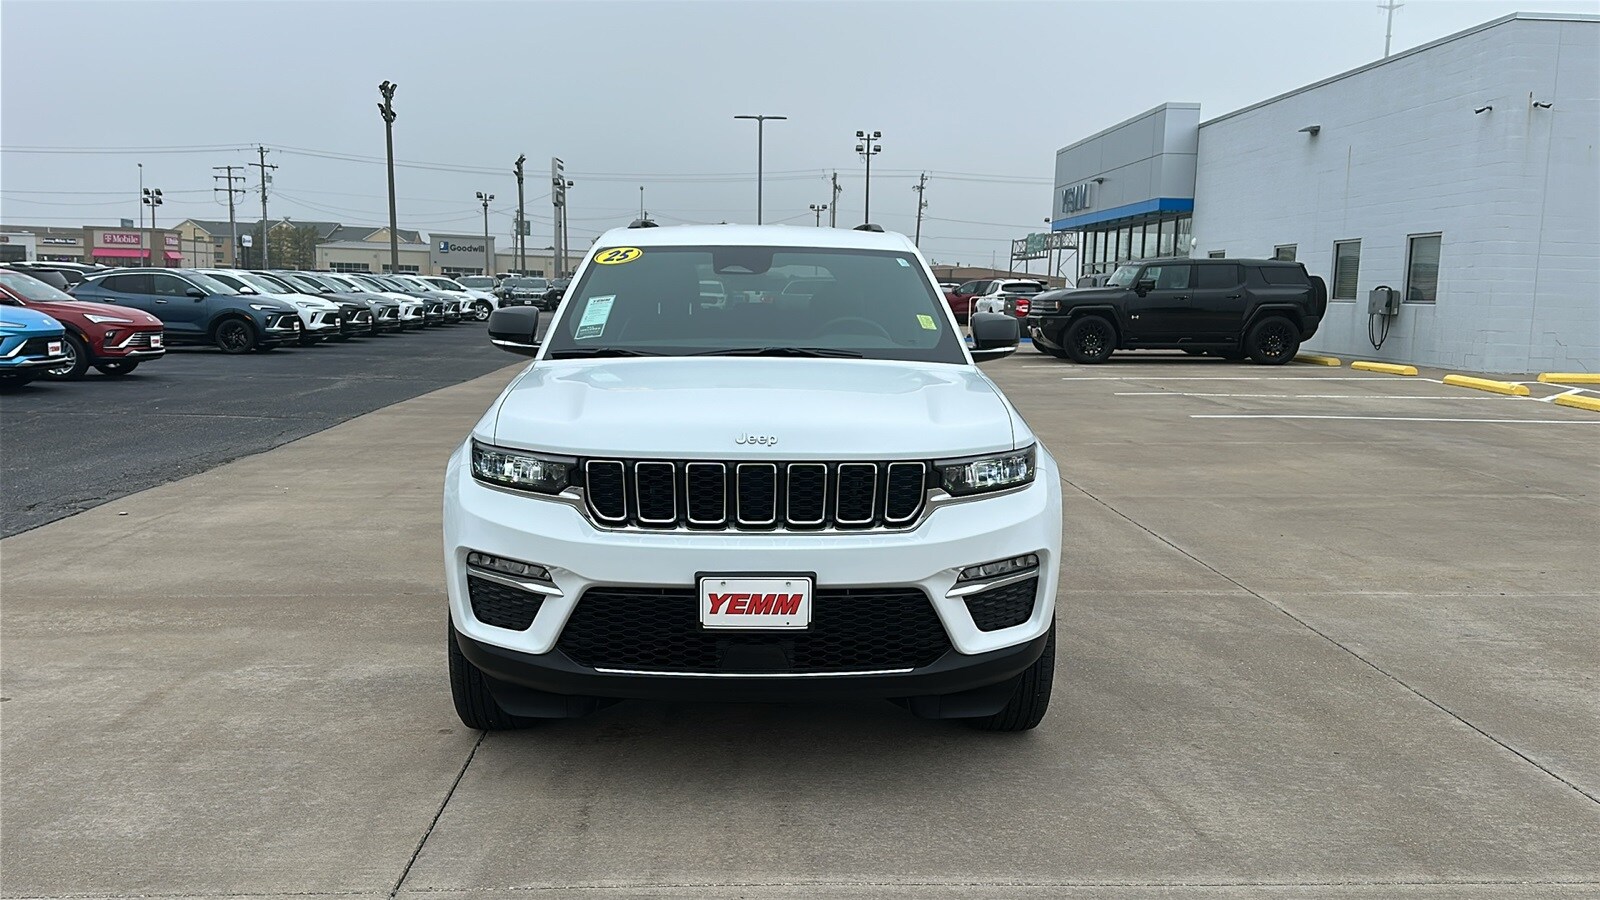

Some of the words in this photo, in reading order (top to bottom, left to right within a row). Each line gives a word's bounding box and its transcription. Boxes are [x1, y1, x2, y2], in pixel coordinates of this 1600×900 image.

[112, 234, 138, 243] Mobile
[450, 244, 484, 252] Goodwill
[603, 249, 634, 262] 25
[735, 432, 778, 447] Jeep
[708, 593, 803, 615] YEMM
